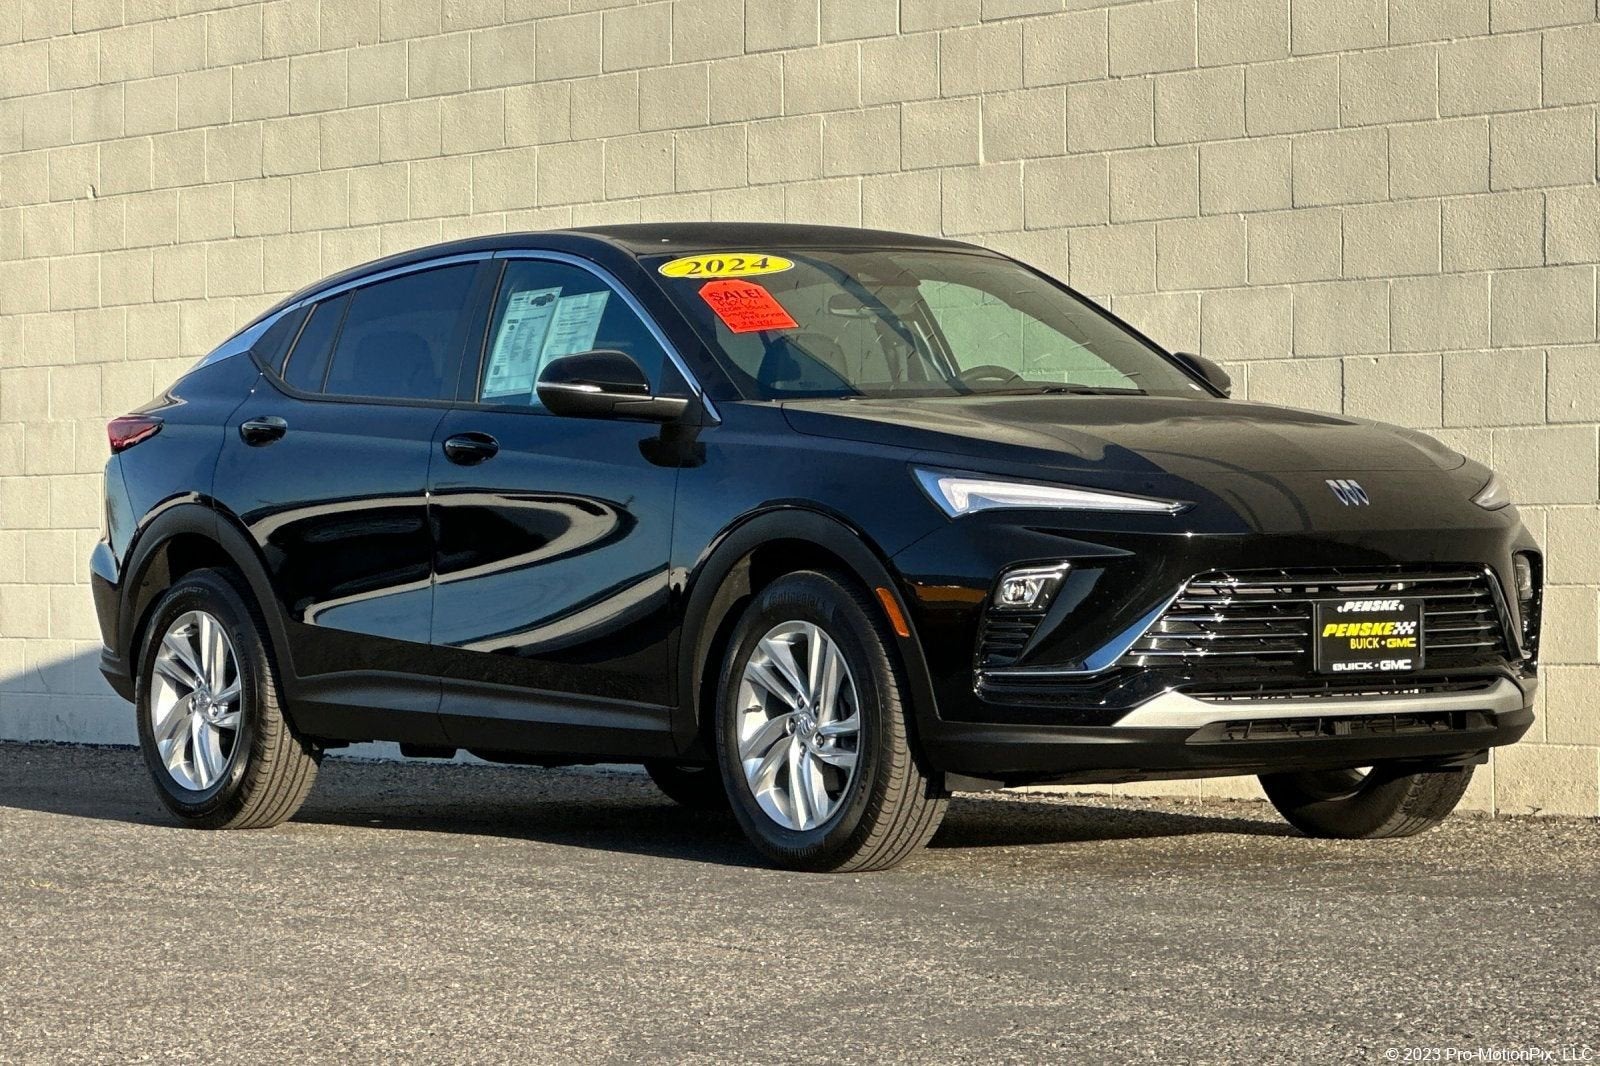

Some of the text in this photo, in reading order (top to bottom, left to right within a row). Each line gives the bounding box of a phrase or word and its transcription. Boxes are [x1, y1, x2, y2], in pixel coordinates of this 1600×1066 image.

[686, 256, 770, 275] 2024
[708, 288, 764, 302] SALE!
[1342, 600, 1401, 612] PENSKE
[1322, 622, 1396, 637] PENSKE
[1350, 637, 1417, 649] BUICK GMC
[1332, 659, 1412, 671] BUICK GMC
